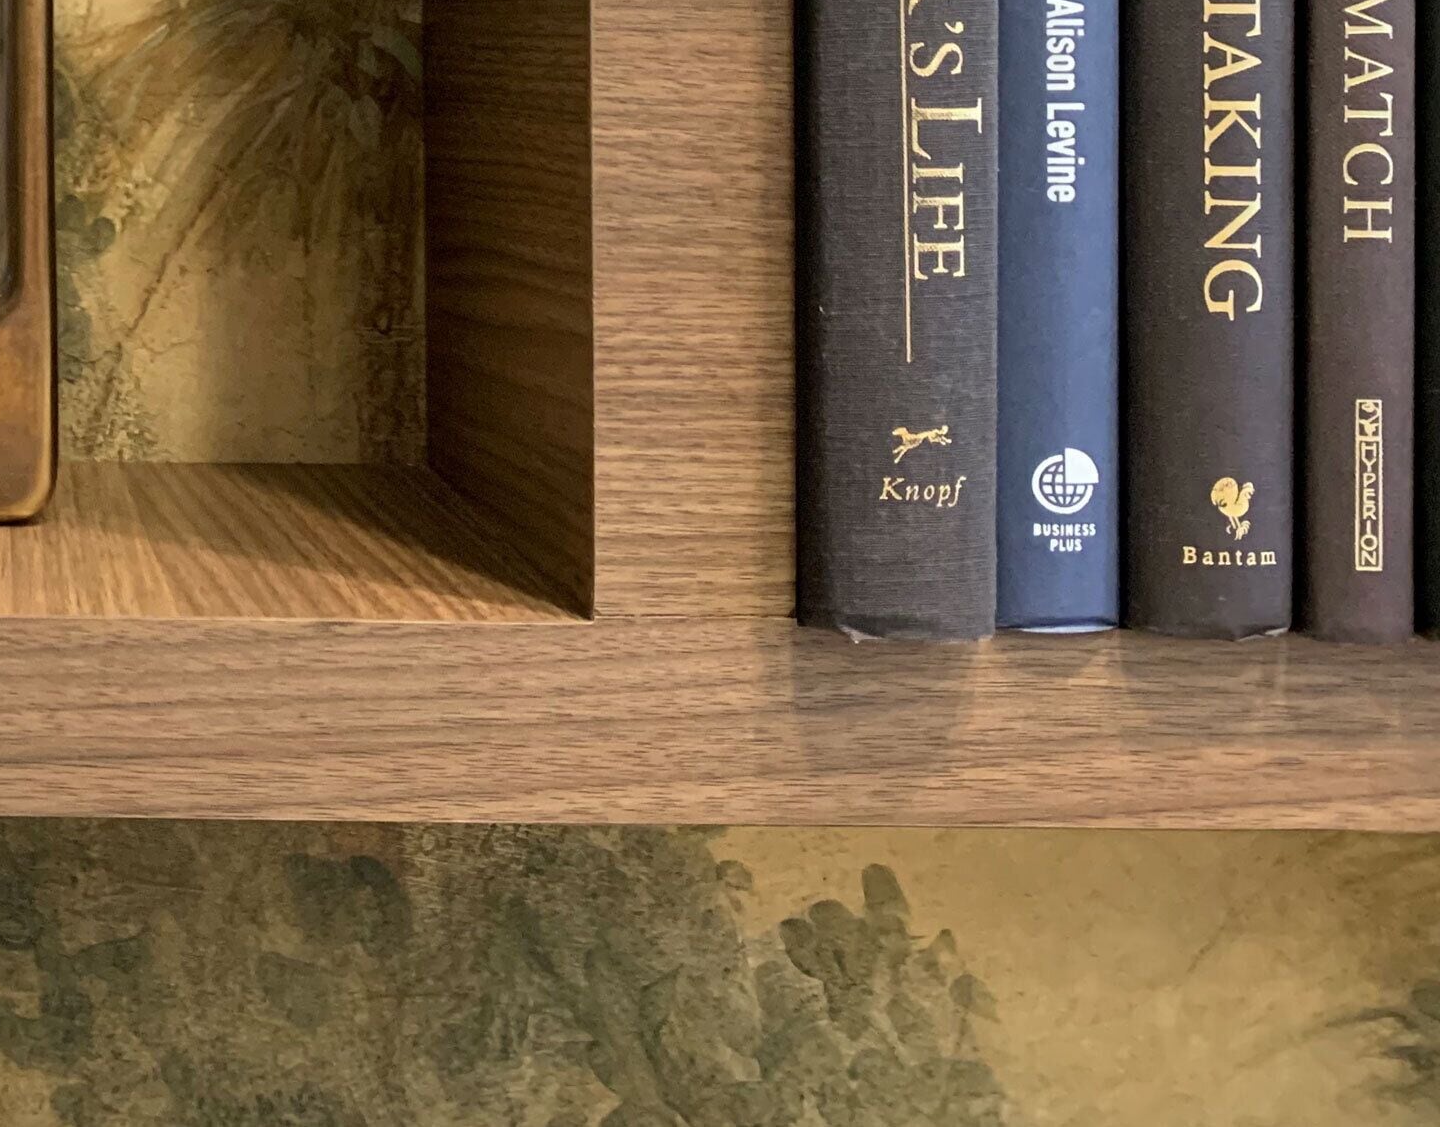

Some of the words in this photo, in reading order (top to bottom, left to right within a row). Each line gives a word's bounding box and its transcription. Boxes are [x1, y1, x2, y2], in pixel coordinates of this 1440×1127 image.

[1045, 101, 1086, 204] Levine
[910, 97, 983, 280] LIFE
[878, 476, 967, 507] Knopf
[1360, 442, 1378, 566] HYPERION
[1033, 523, 1097, 538] BUSINESS
[1049, 538, 1083, 553] PLUS
[1182, 545, 1278, 567] Bantam
